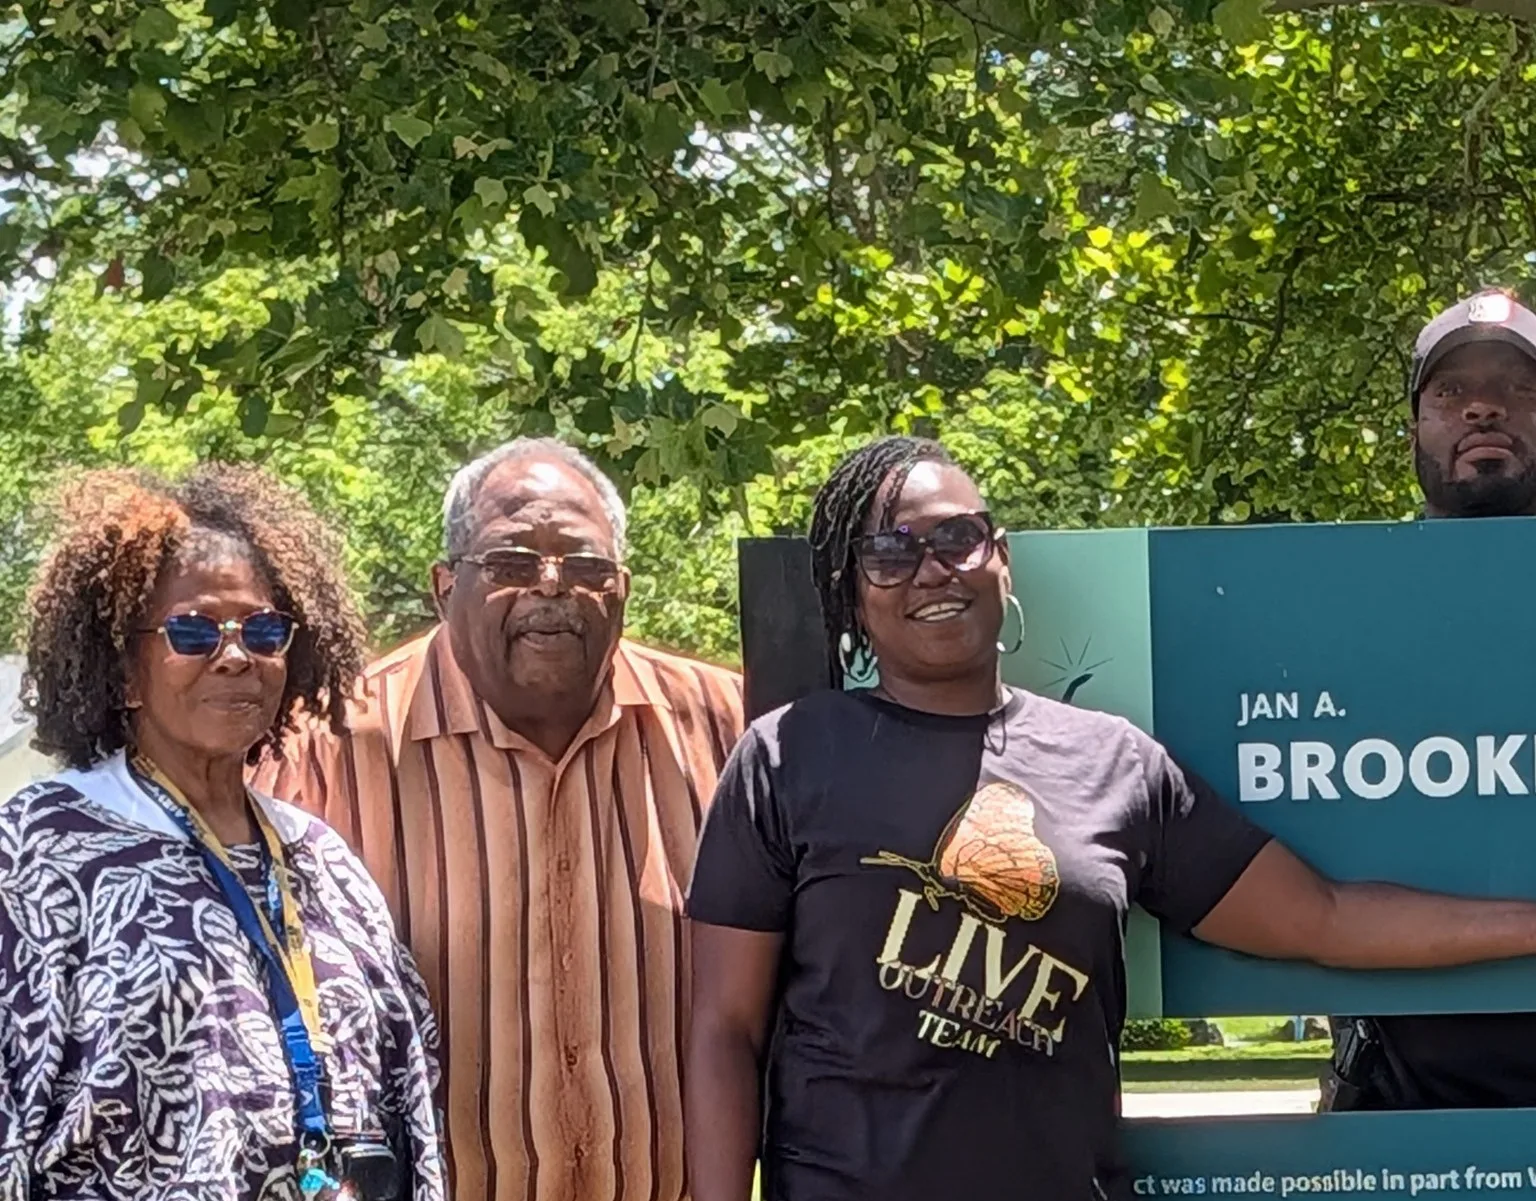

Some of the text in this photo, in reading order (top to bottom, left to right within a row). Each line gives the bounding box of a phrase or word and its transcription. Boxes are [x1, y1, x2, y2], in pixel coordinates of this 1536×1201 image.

[1237, 690, 1347, 727] JAN A.
[876, 888, 1089, 1042] LIVE
[878, 960, 1054, 1057] OUTREACH
[917, 1009, 1001, 1058] TEAM
[1161, 1176, 1207, 1195] was
[1211, 1171, 1275, 1194] made
[1281, 1169, 1376, 1198] possible
[1382, 1168, 1405, 1192] in
[1410, 1169, 1460, 1197] part
[1464, 1166, 1522, 1190] from
